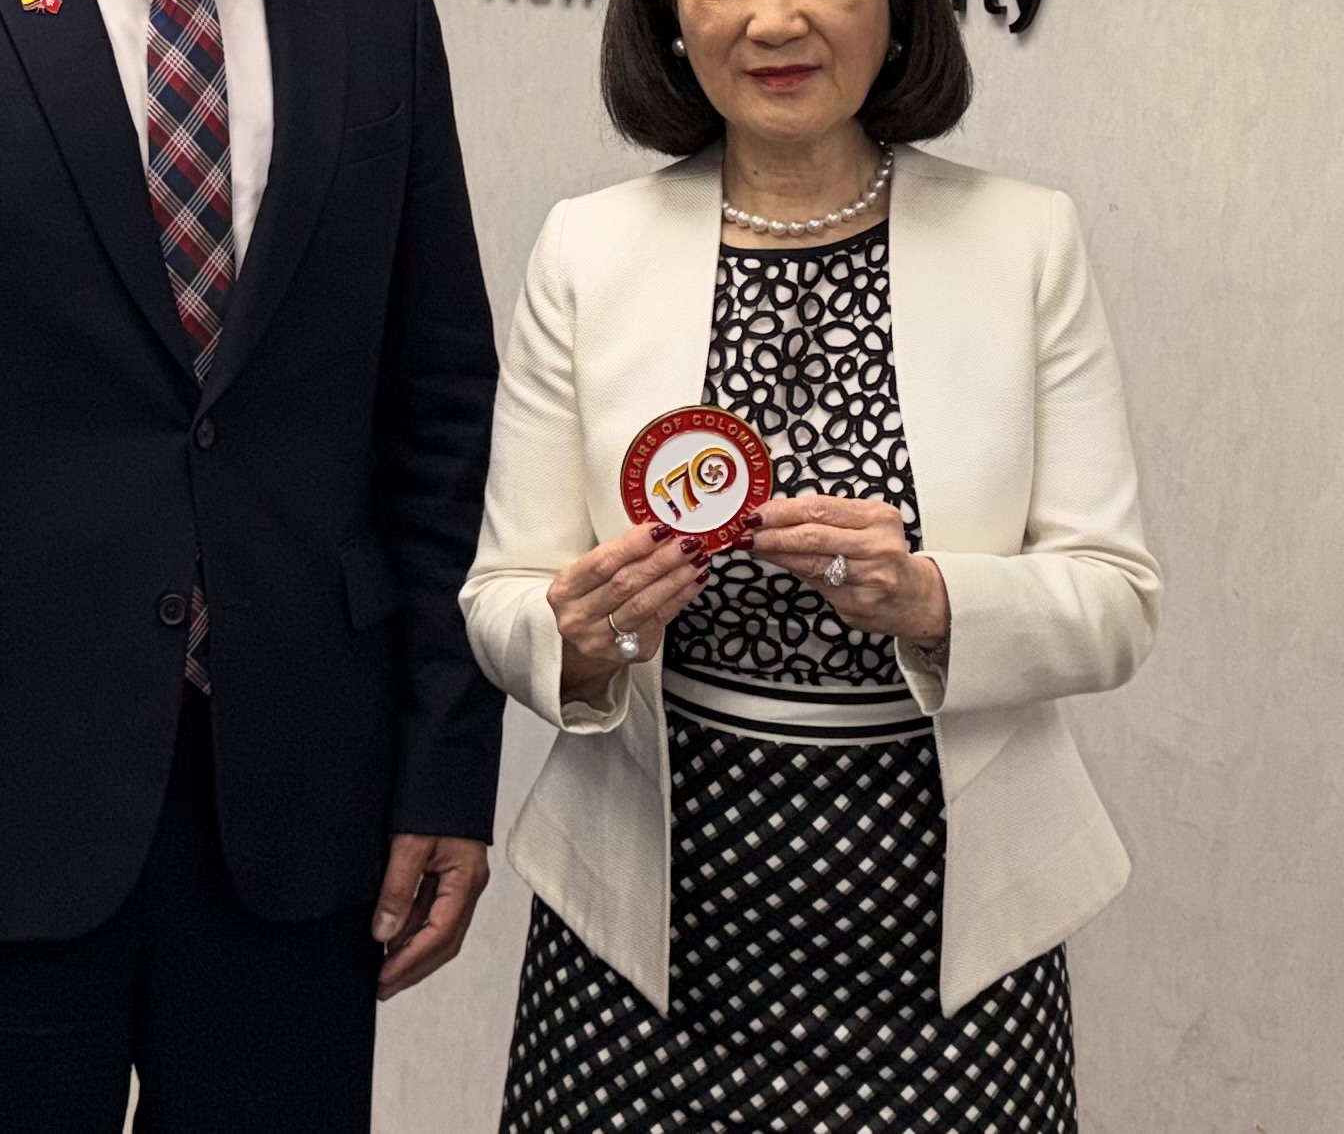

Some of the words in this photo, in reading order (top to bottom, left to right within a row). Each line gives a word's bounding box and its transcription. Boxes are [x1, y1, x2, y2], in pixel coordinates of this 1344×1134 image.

[629, 435, 657, 491] YEARS
[661, 417, 683, 434] OF
[692, 414, 765, 472] COLOMBIA
[753, 479, 766, 497] IN
